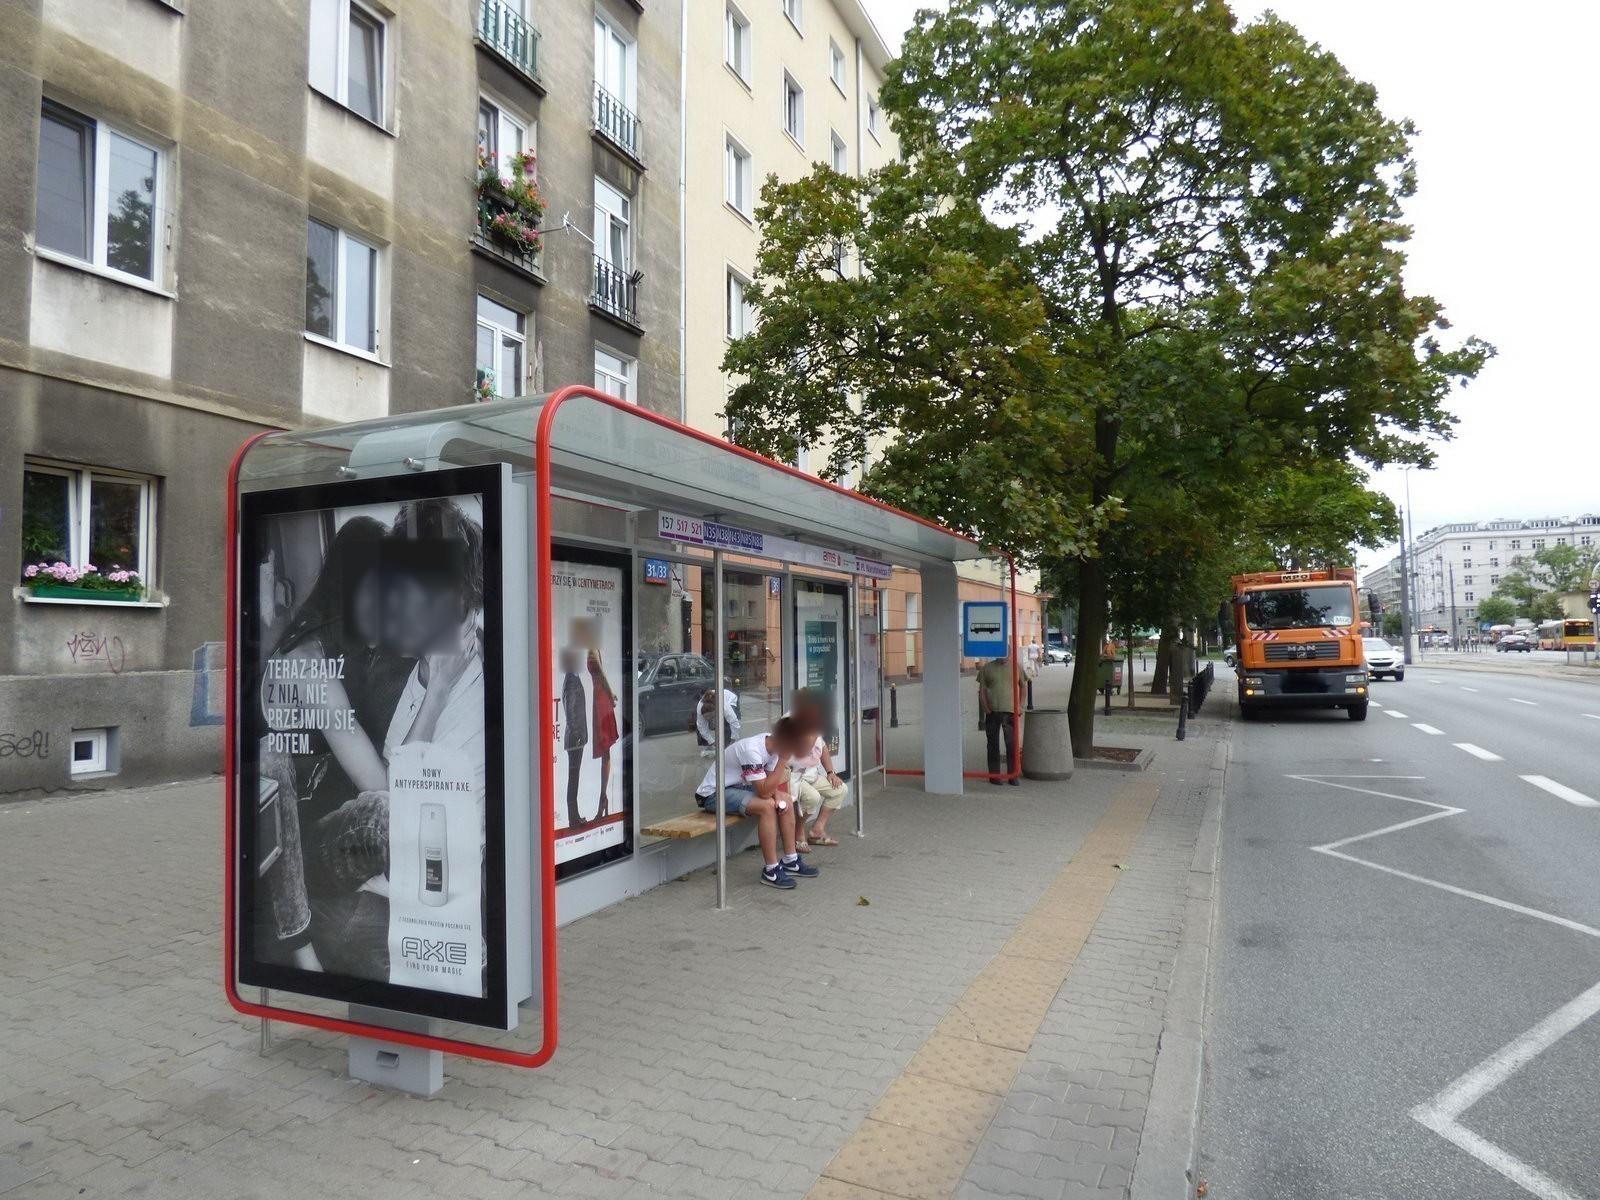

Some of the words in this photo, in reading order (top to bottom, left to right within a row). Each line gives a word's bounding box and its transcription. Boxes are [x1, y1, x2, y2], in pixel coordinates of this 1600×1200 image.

[662, 516, 674, 529] 157
[677, 519, 688, 532] 517
[692, 522, 702, 535] 521
[268, 659, 307, 679] TERAZ
[311, 654, 345, 682] BĄDŹ
[268, 684, 275, 703] Z
[279, 684, 303, 707] NIĄ,
[306, 684, 328, 704] NIE
[268, 708, 330, 729] PRZEJMUJ
[335, 709, 356, 734] SIĘ
[268, 732, 314, 754] POTEM.
[422, 768, 441, 777] NOWY
[394, 779, 453, 791] ANTYPERSPIRANT
[456, 782, 472, 792] AXE.
[401, 936, 467, 965] AXE
[406, 961, 420, 970] FIND
[422, 964, 439, 973] YOUR
[442, 966, 463, 976] MAGIC
